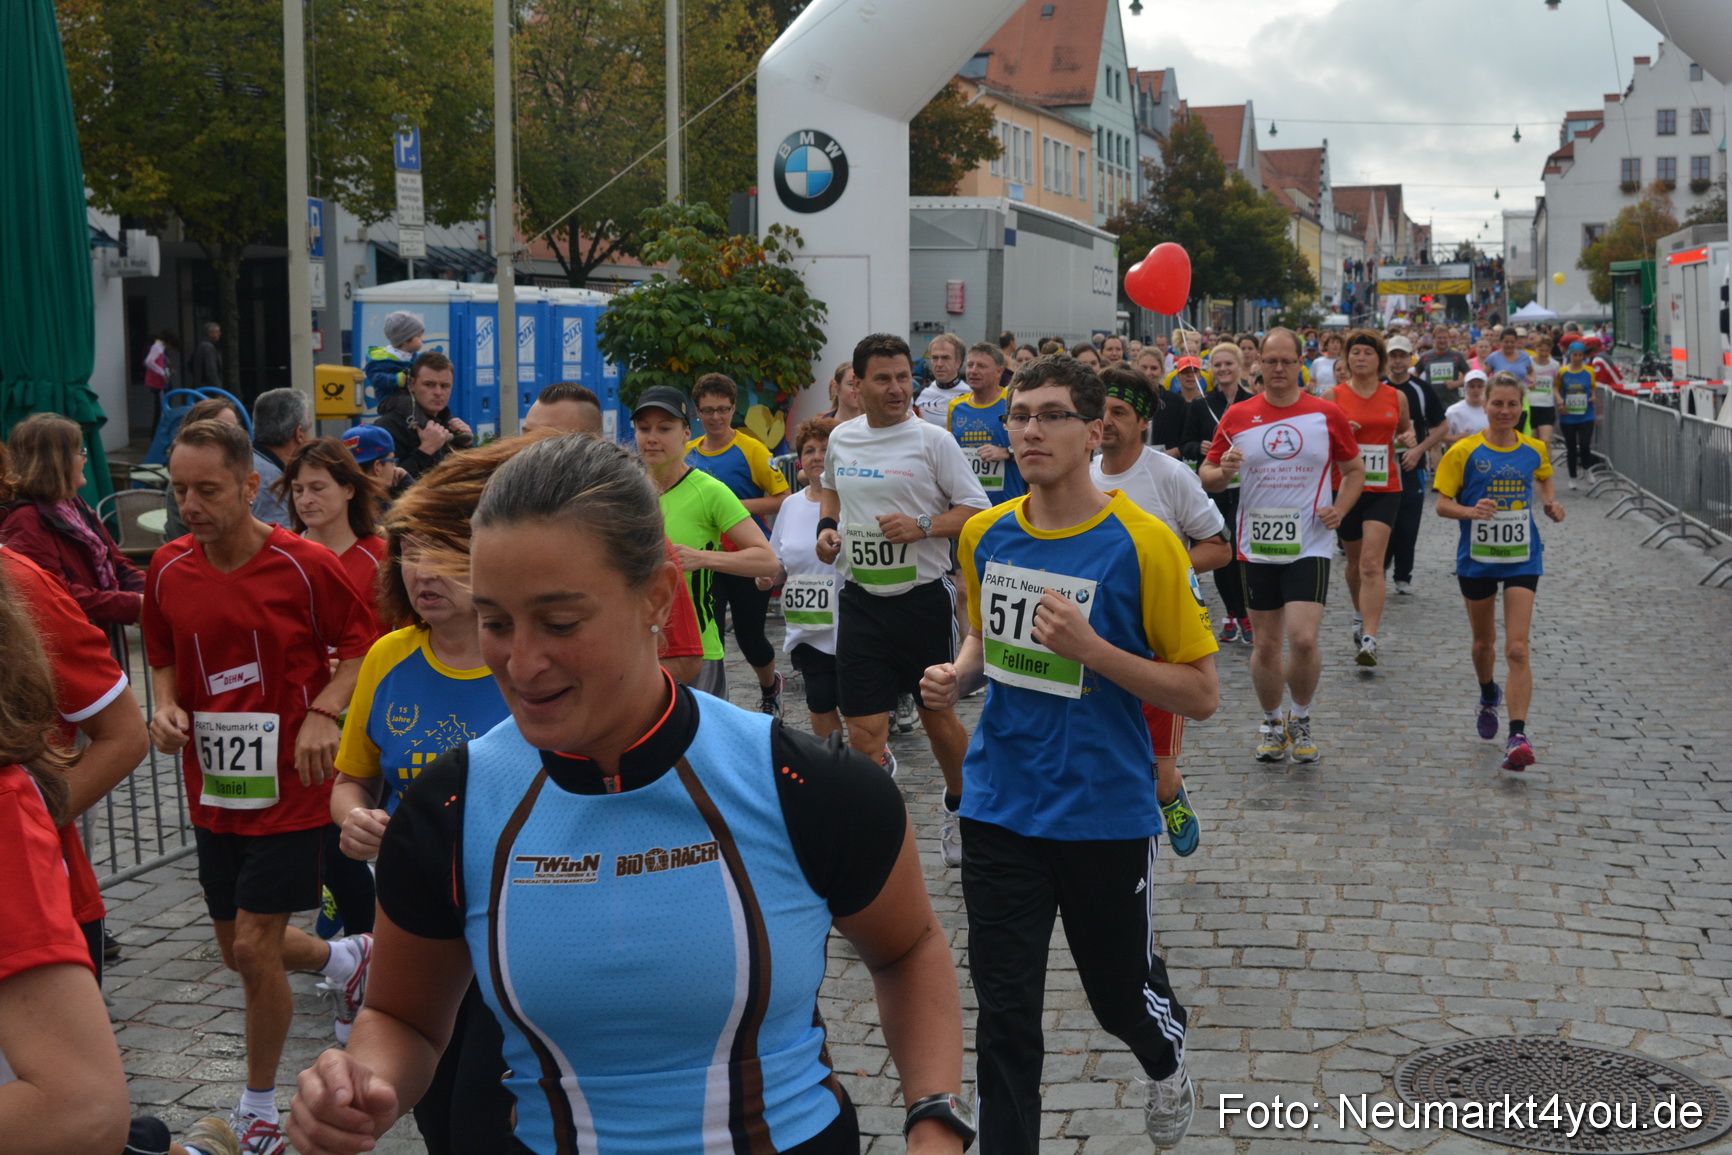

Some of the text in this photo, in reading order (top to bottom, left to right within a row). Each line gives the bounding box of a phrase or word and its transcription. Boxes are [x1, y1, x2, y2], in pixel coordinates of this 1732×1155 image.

[779, 131, 842, 159] BMW
[344, 281, 352, 300] 3
[1407, 283, 1440, 292] START
[967, 457, 1001, 475] 097
[846, 529, 866, 537] PARTL
[1252, 521, 1297, 541] 5229
[1477, 523, 1524, 543] 5103
[852, 540, 909, 566] 5507
[985, 573, 1018, 589] PARTL
[785, 588, 829, 609] 5520
[1002, 648, 1050, 676] Fellner
[223, 672, 244, 686] DEHN
[399, 706, 408, 714] 15
[195, 721, 259, 731] PARTL Neumarkt
[200, 736, 263, 771] 5121
[215, 780, 247, 796] Daniel
[669, 840, 719, 870] RACER
